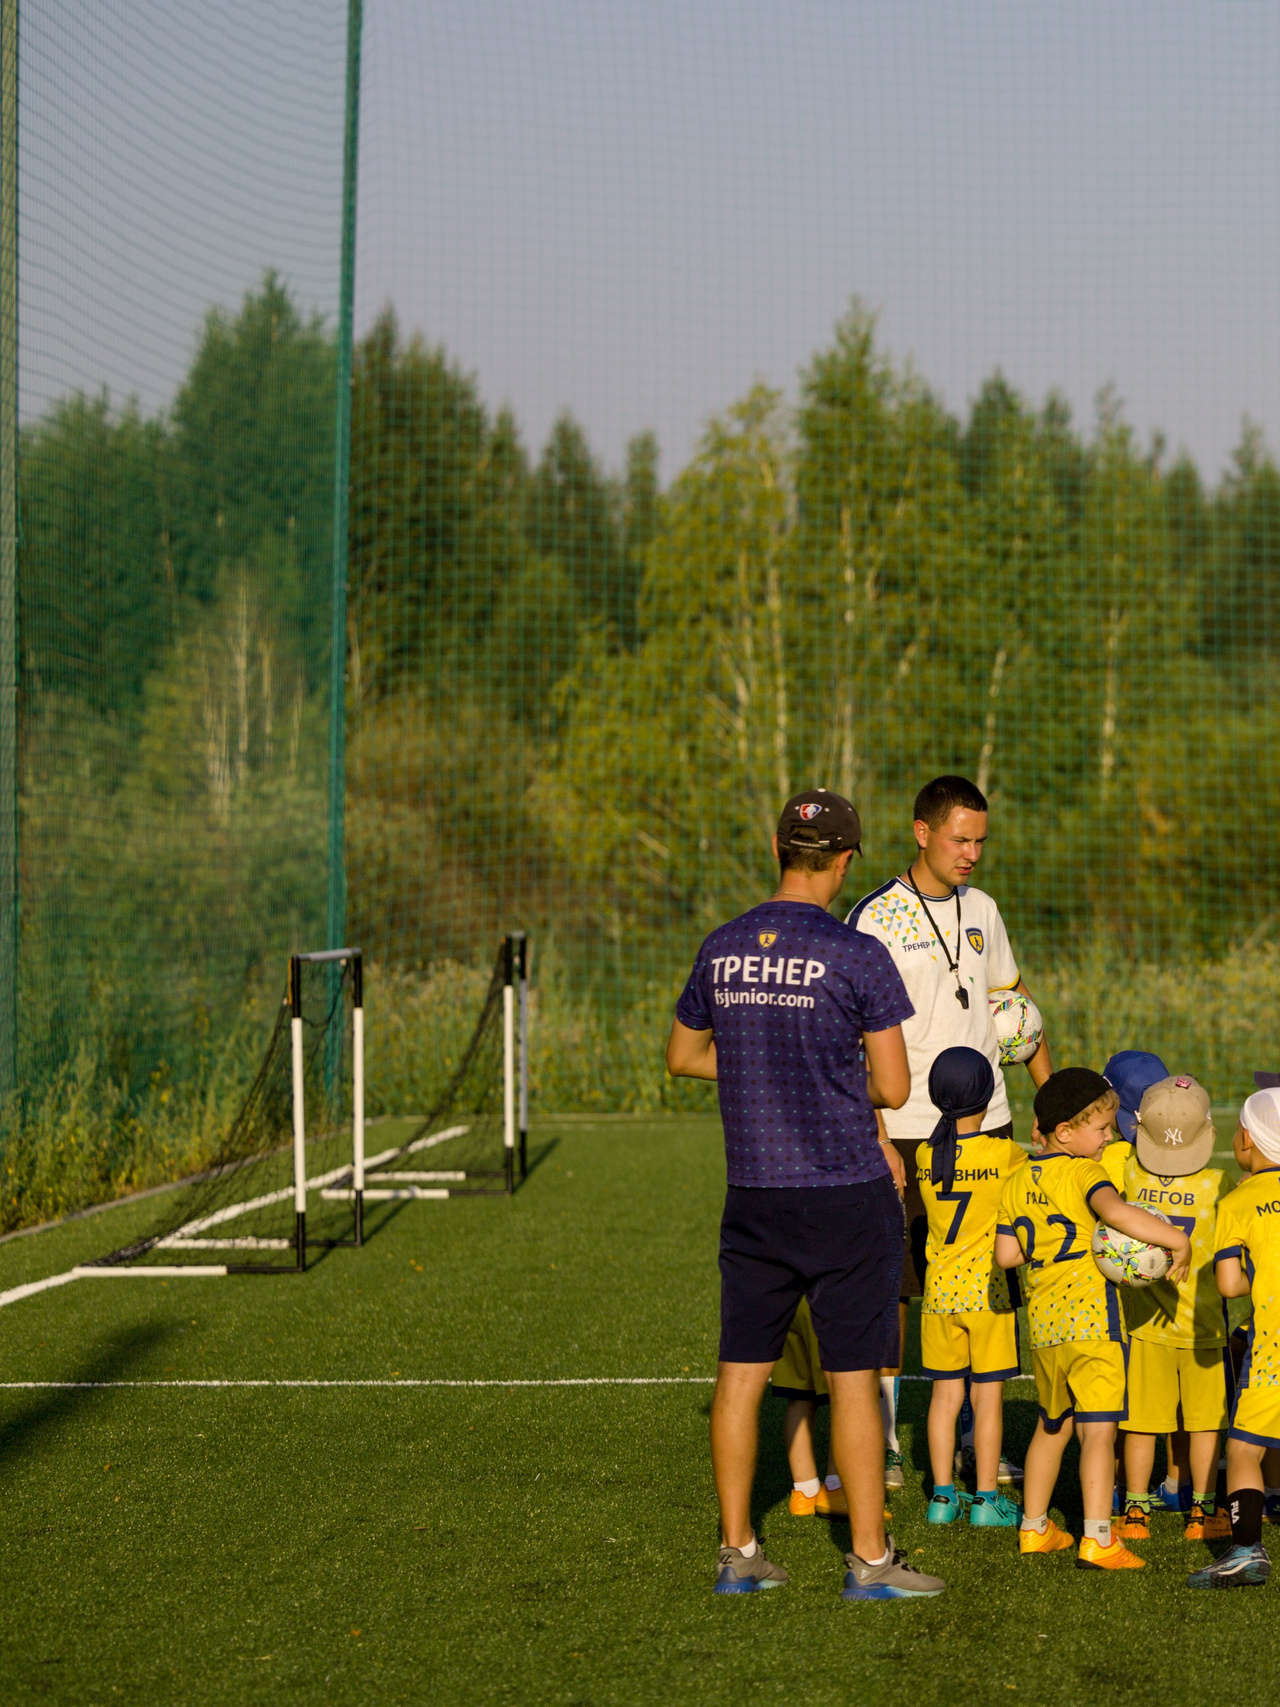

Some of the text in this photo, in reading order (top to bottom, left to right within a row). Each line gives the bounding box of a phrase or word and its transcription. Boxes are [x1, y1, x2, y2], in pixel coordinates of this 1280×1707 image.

[902, 941, 931, 953] ТРЕНЕР
[711, 955, 826, 987] ТРЕНЕР
[714, 987, 815, 1009] fsjunior.com
[1137, 1188, 1195, 1206] ЛЕГОВ
[935, 1191, 973, 1245] 7
[1013, 1213, 1088, 1270] 22
[1230, 1500, 1240, 1525] FILA
